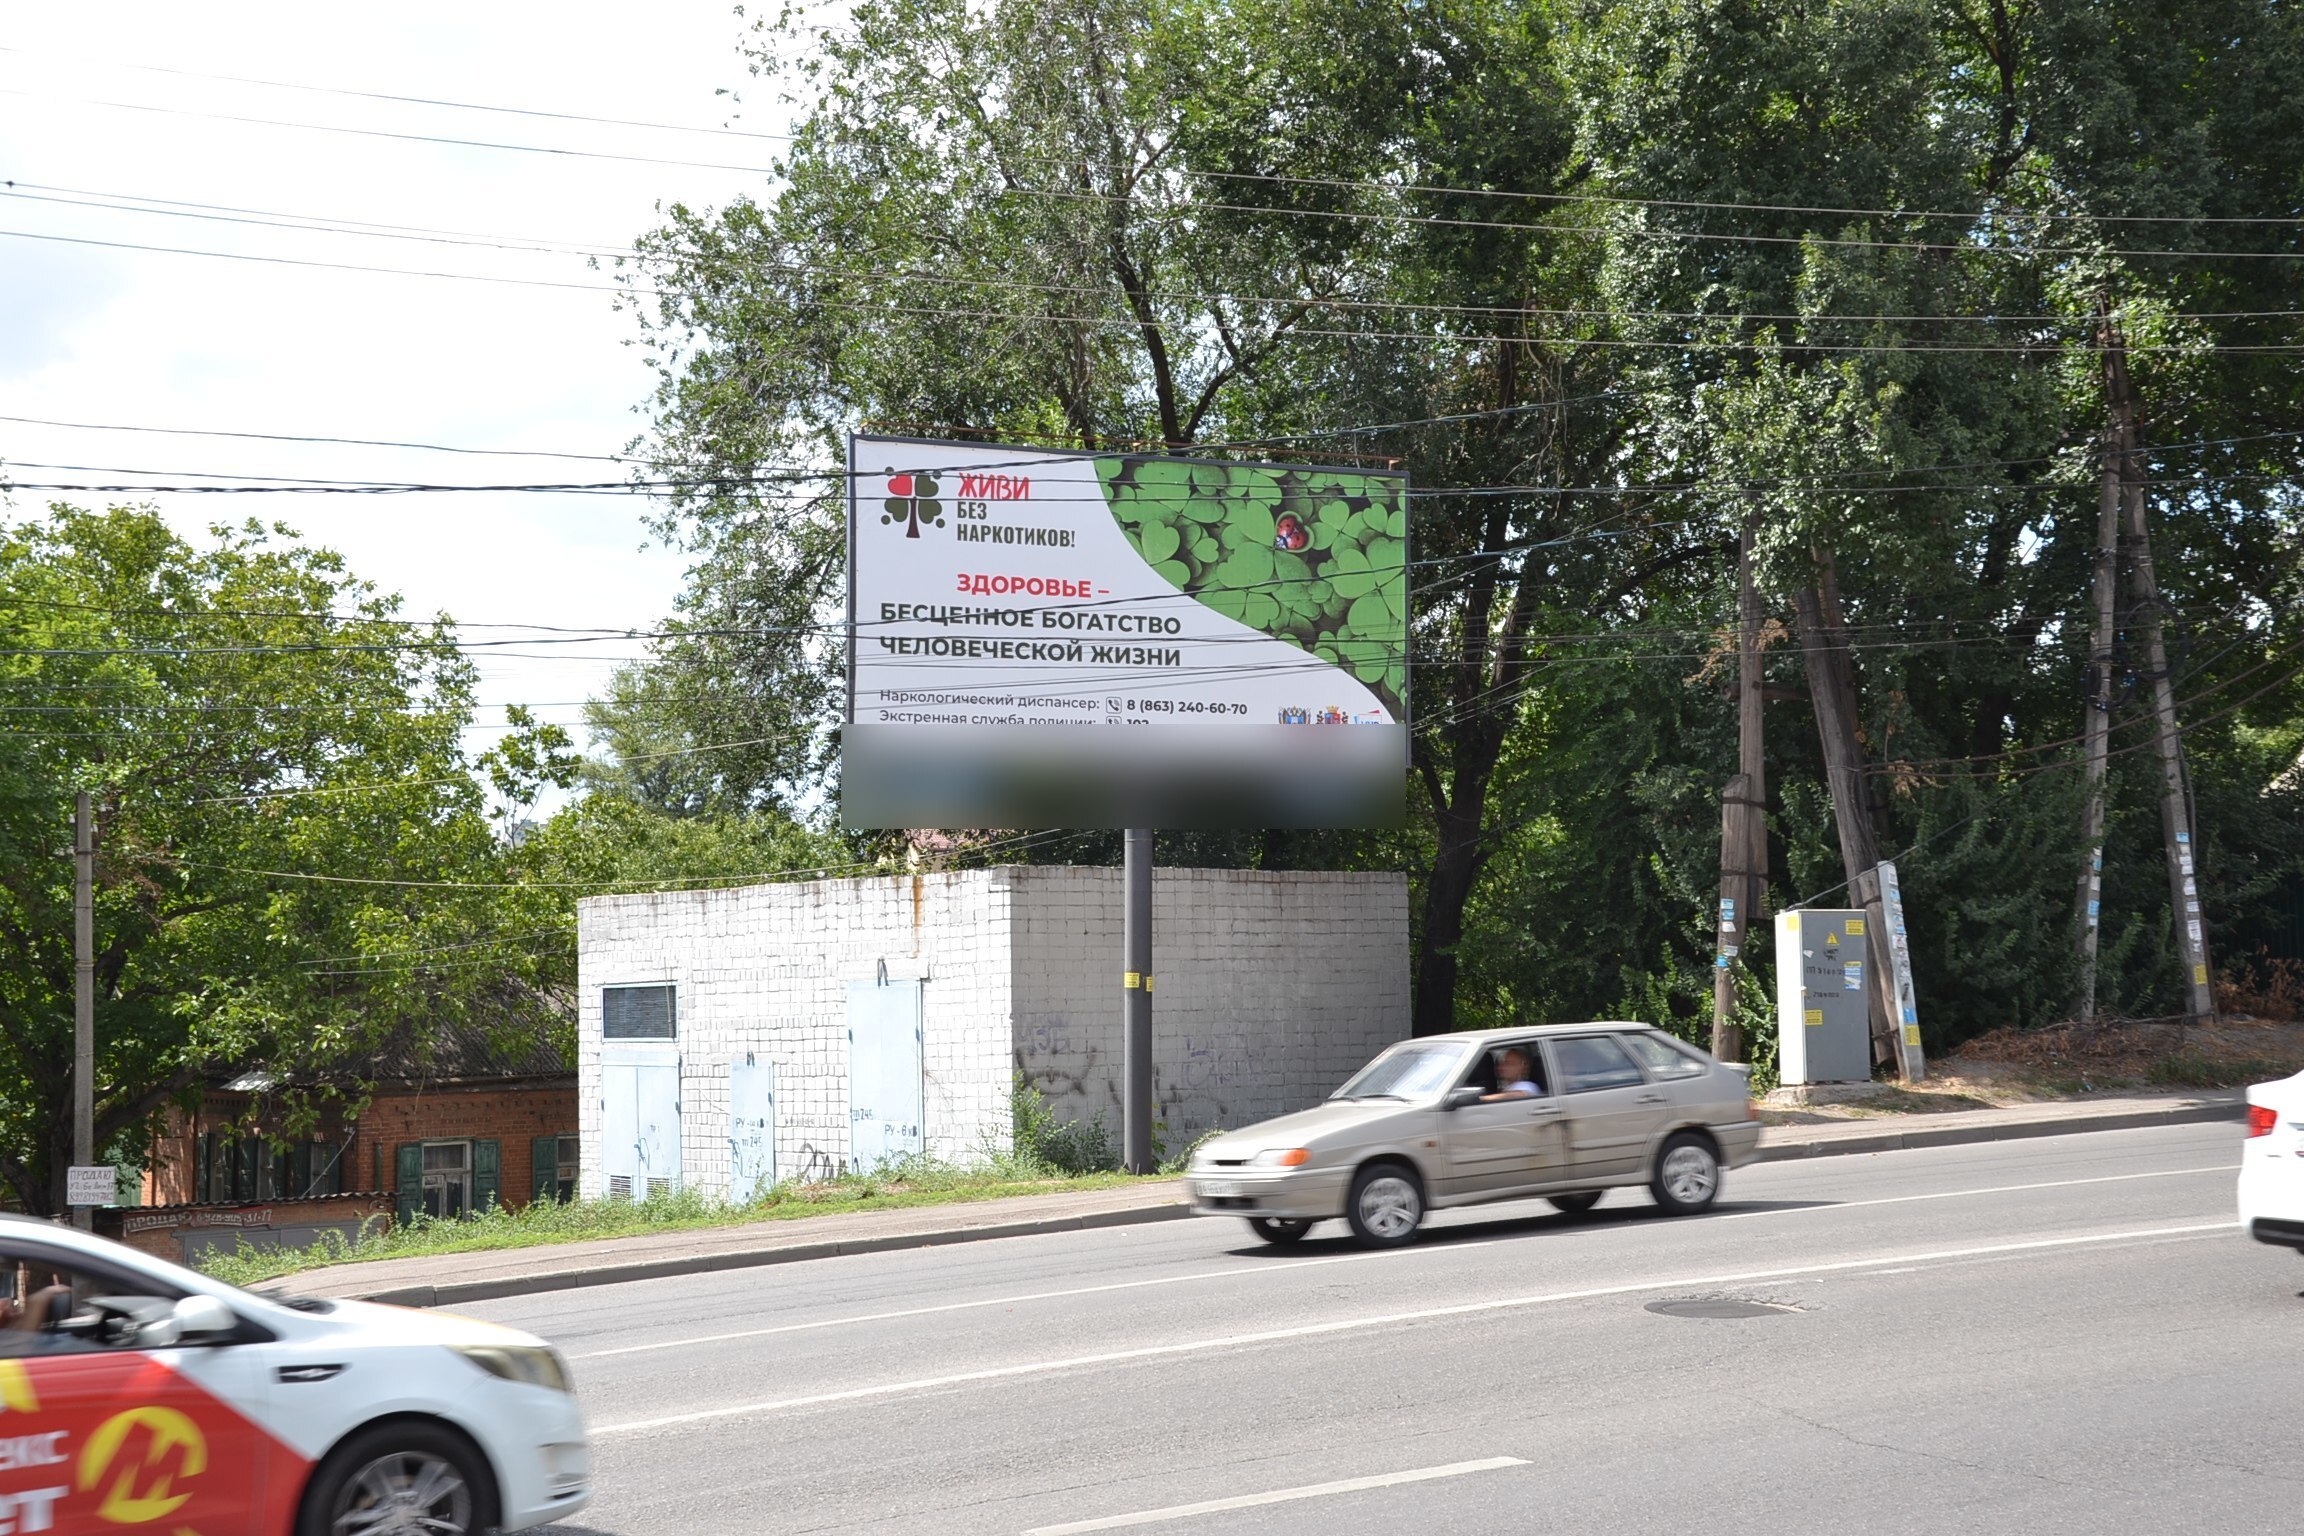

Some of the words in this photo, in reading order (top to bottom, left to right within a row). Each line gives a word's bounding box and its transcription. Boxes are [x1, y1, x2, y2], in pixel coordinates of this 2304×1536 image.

[958, 472, 1030, 500] ЖИВИ
[957, 501, 987, 520] БЕЗ
[957, 524, 1076, 548] НАРКОТИКОВ!
[957, 573, 1091, 598] ЗДОРОВЬЕ
[881, 603, 1034, 627] БЕСЦЕННОЕ
[1042, 611, 1181, 635] БОГАТСТВО
[880, 636, 1082, 662] ЧЕЛОВЕЧЕСКОЙ
[1090, 645, 1180, 666] ЖИЗНИ
[880, 690, 1013, 706] Наркологический
[1018, 697, 1100, 711] диспансер:
[1127, 699, 1136, 710] 8
[1140, 699, 1174, 714] (863)
[1178, 701, 1247, 714] 240-60-70
[880, 710, 967, 724] Экстренная
[70, 1170, 112, 1180] ПРОДАЮ
